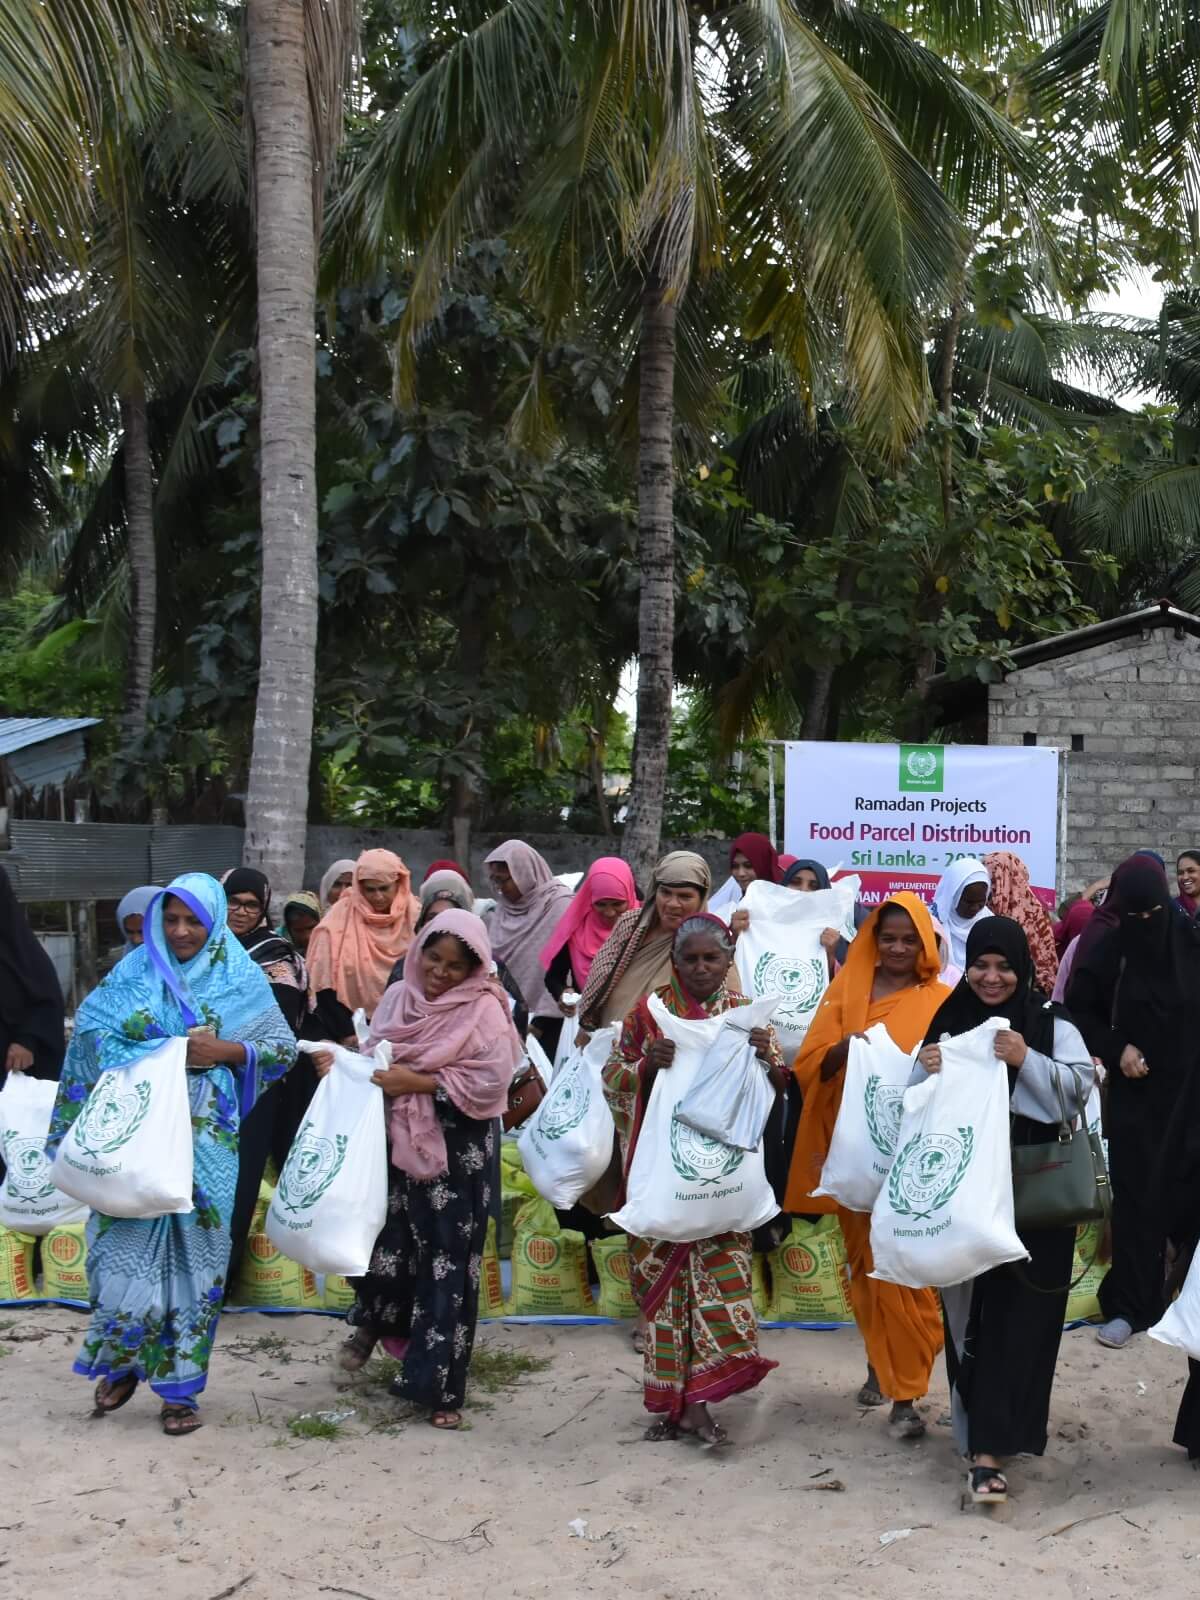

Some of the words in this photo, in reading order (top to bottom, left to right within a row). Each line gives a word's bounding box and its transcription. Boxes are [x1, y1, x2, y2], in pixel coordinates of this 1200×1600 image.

[855, 797, 924, 812] Ramadan
[931, 799, 986, 816] Projects
[810, 821, 854, 840] Food
[860, 822, 915, 842] Parcel
[922, 823, 1031, 844] Distribution
[851, 850, 872, 866] Sri
[878, 849, 926, 867] Lanka
[889, 881, 936, 890] IMPLEMENTED
[88, 1161, 122, 1176] Appeal
[675, 1191, 709, 1201] Human
[711, 1182, 743, 1198] Appeal
[31, 1203, 59, 1216] Appeal
[892, 1227, 923, 1238] Human
[926, 1215, 952, 1238] Appeal
[256, 1270, 281, 1281] 10KG
[533, 1275, 560, 1285] 10KG
[794, 1284, 821, 1293] 10KG
